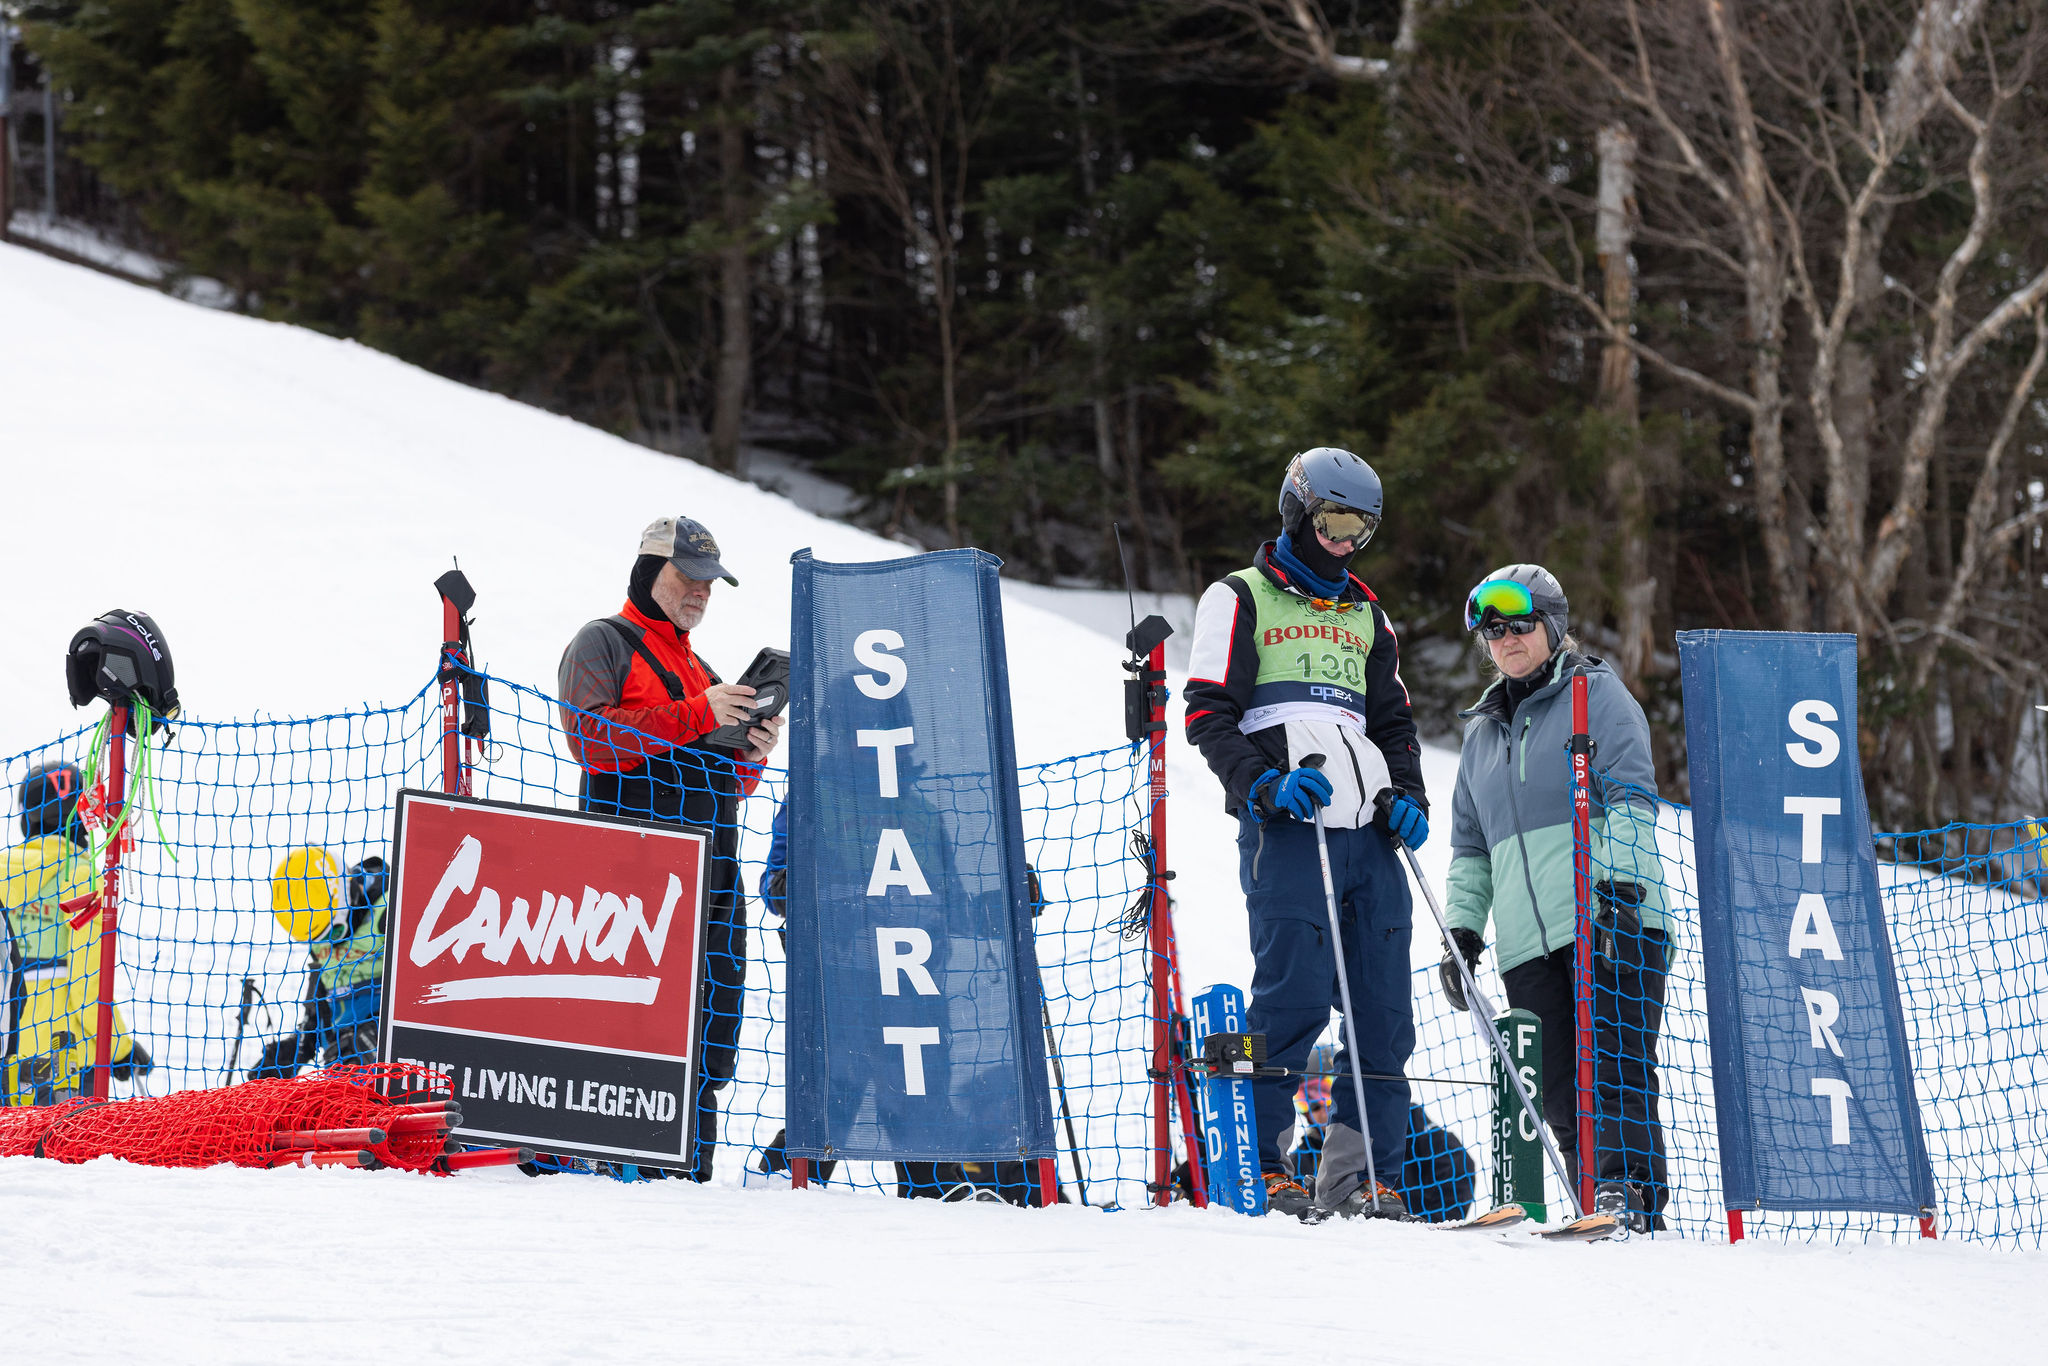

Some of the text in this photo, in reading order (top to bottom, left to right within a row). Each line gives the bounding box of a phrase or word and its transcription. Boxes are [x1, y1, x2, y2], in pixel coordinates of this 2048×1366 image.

[1263, 624, 1370, 654] BODEFEST
[1295, 651, 1362, 688] 130
[409, 834, 683, 968] CANNON
[852, 628, 941, 1096] START
[1783, 699, 1854, 1145] START
[397, 1057, 677, 1122] THE LIVING LEGEND
[1222, 993, 1256, 1210] HOERNESS
[1243, 1035, 1253, 1060] ALGE
[1517, 1024, 1538, 1142] FSC
[1490, 1021, 1500, 1208] RANCONI
[1501, 1117, 1514, 1204] CLUB
